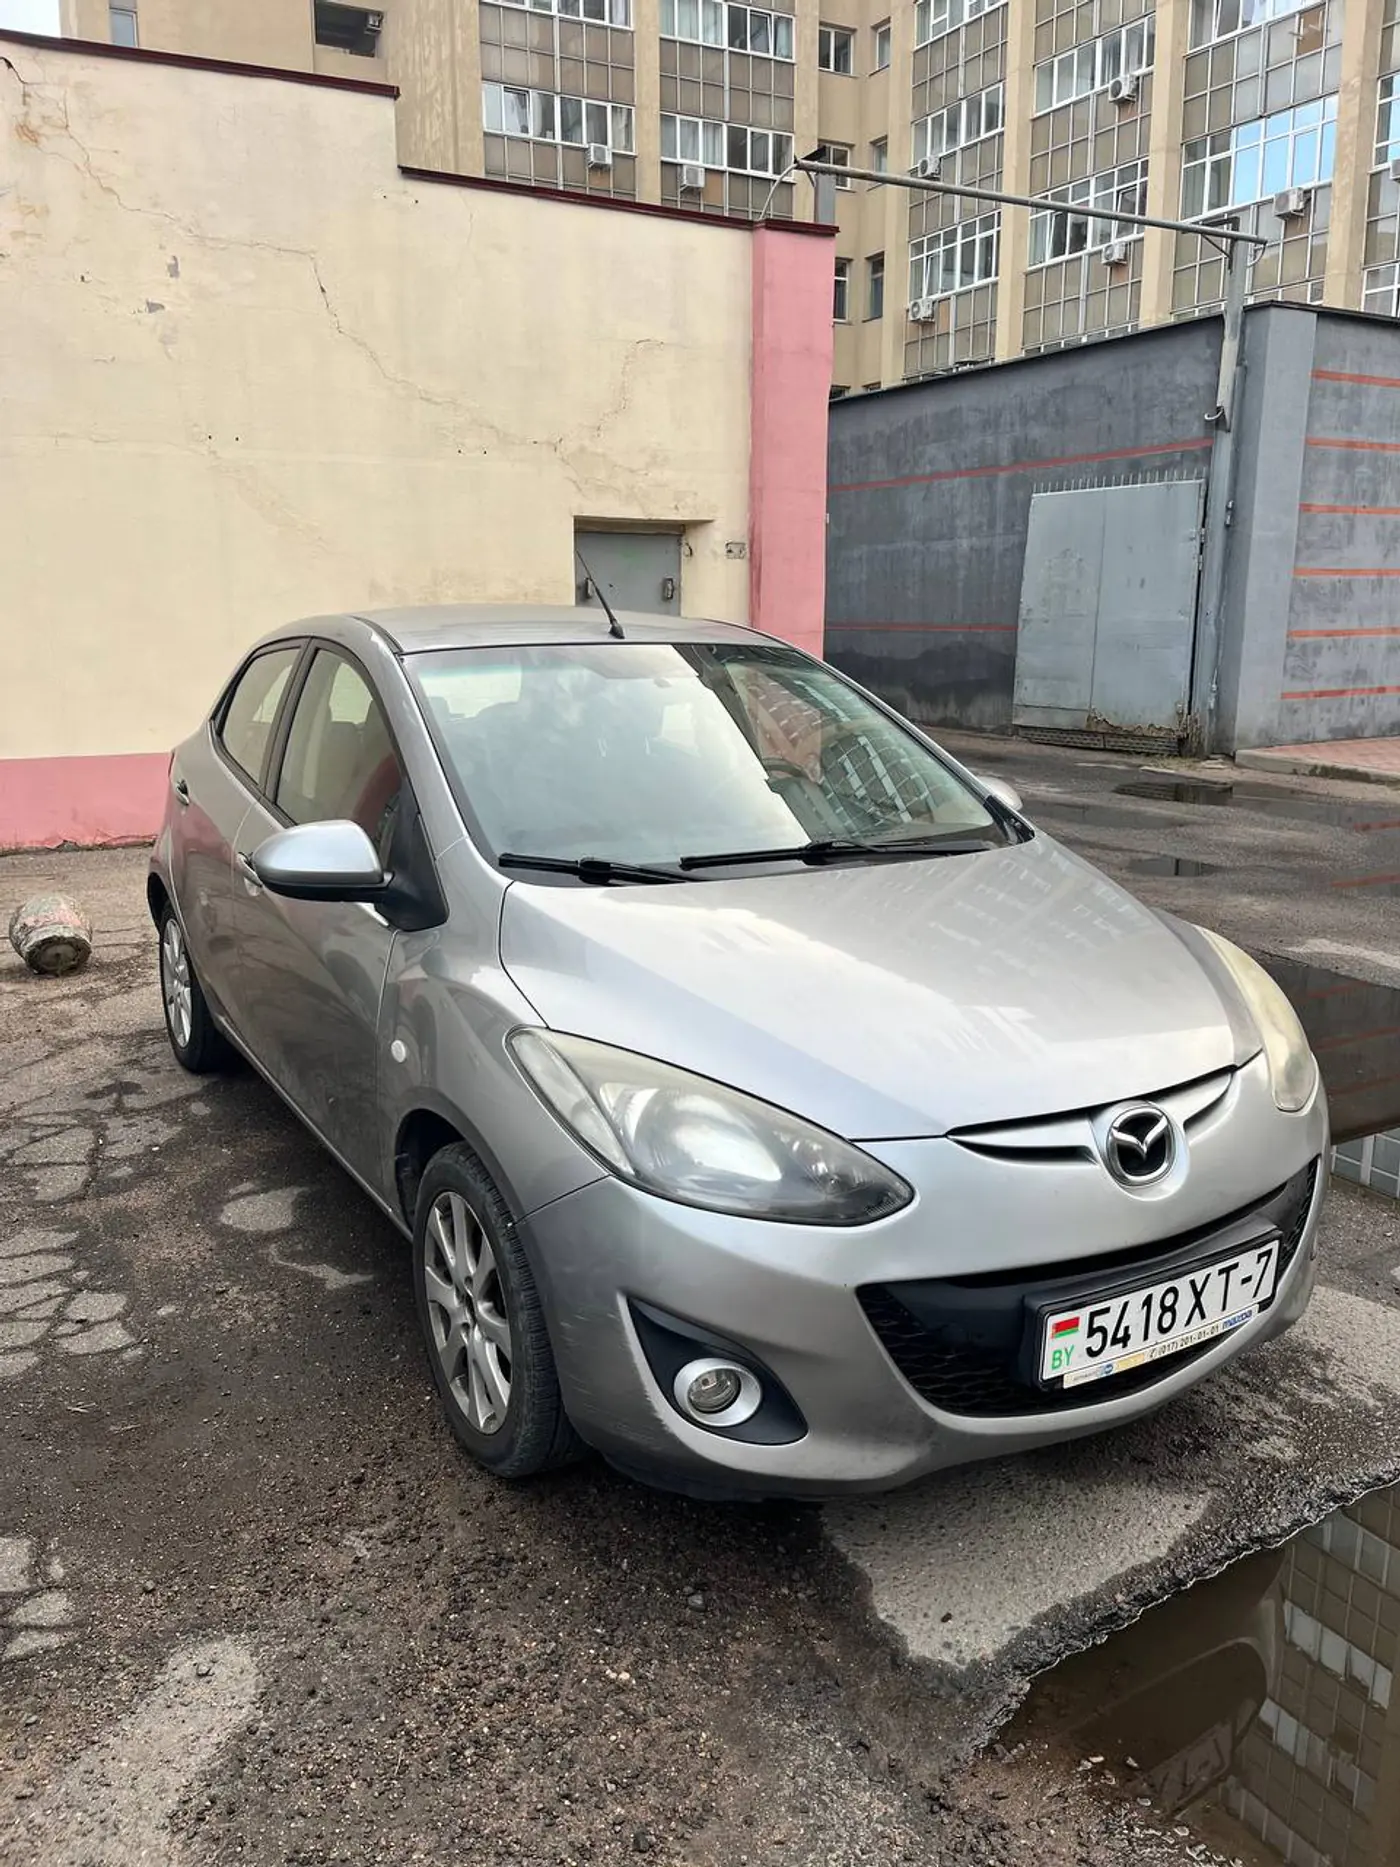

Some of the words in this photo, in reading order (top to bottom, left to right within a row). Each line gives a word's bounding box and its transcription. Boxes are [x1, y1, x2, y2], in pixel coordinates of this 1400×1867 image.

[1222, 1309, 1253, 1330] mazda
[1180, 1324, 1220, 1348] 201-01-01
[1051, 1345, 1075, 1370] BY
